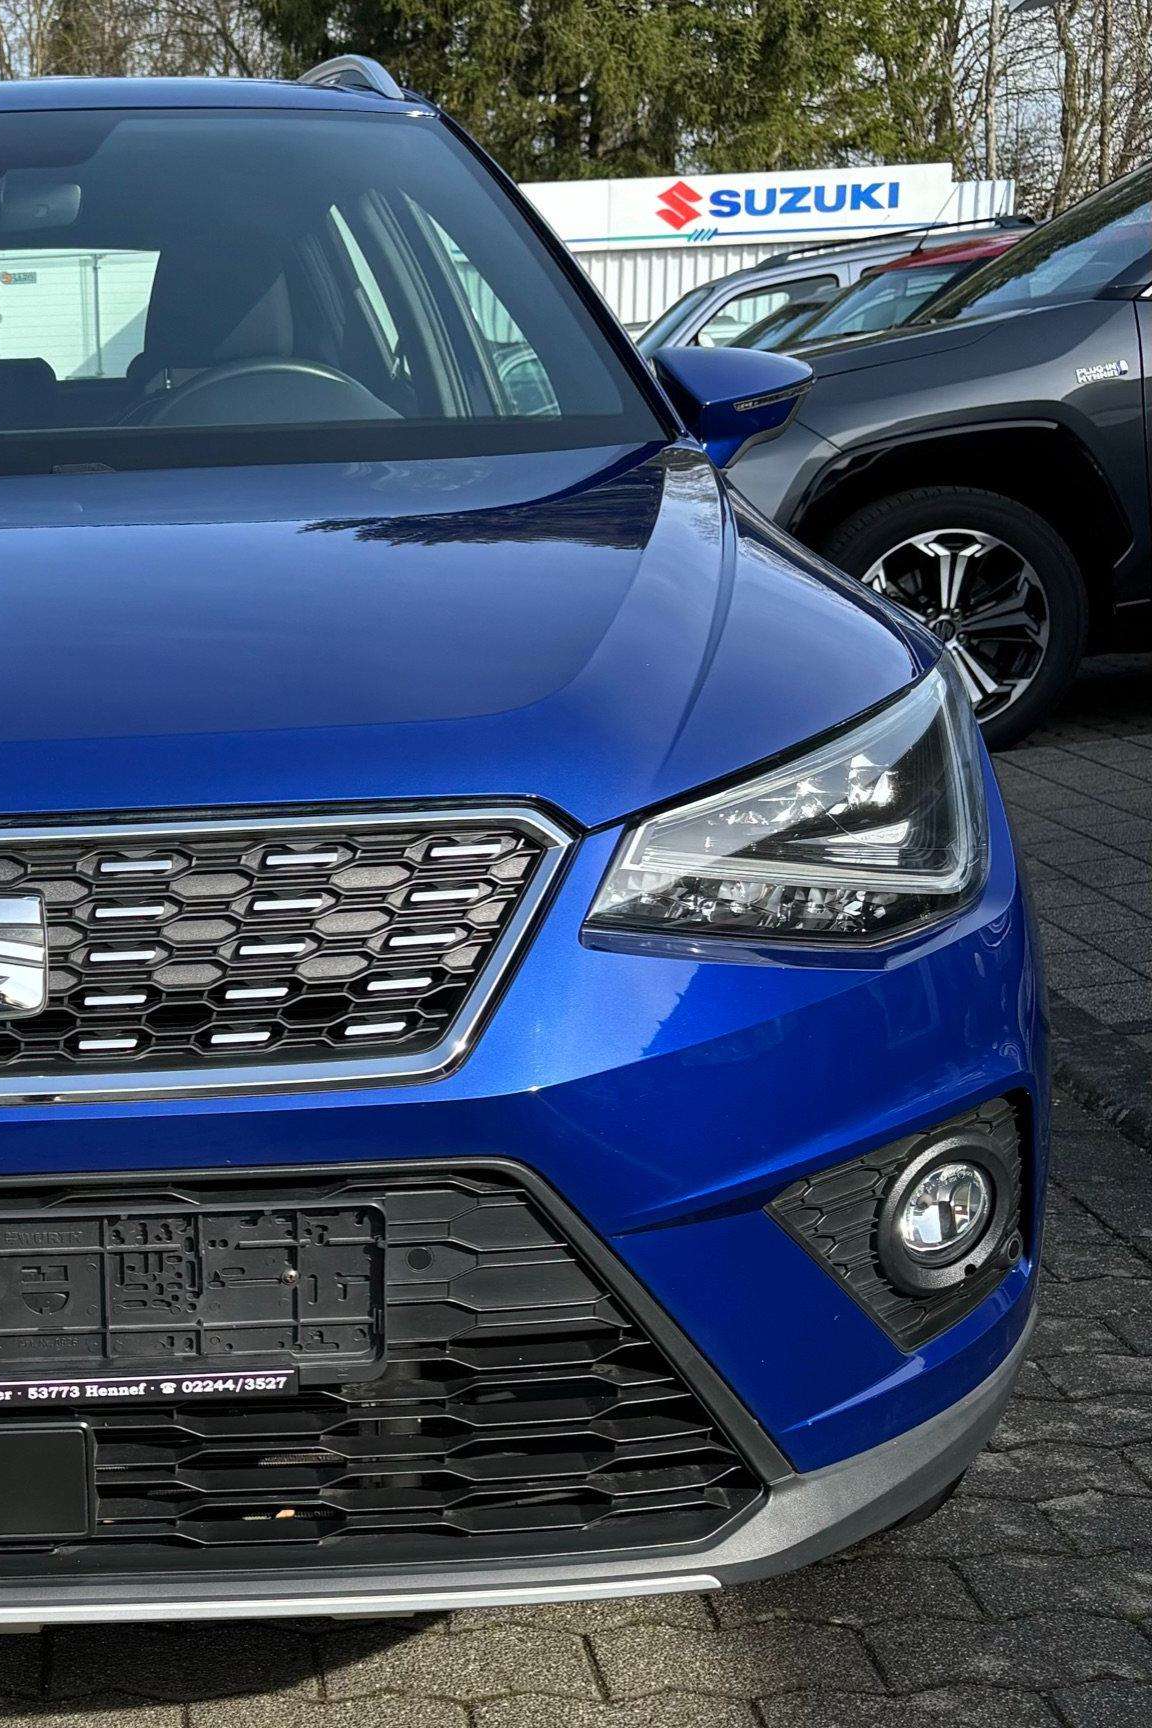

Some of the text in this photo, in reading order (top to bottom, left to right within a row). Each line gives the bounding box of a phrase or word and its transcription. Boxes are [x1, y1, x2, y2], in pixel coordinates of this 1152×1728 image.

[709, 182, 900, 217] SUZUKI
[27, 1386, 80, 1400] 53773
[85, 1383, 146, 1397] Hennef
[181, 1377, 287, 1394] 02244/3527
